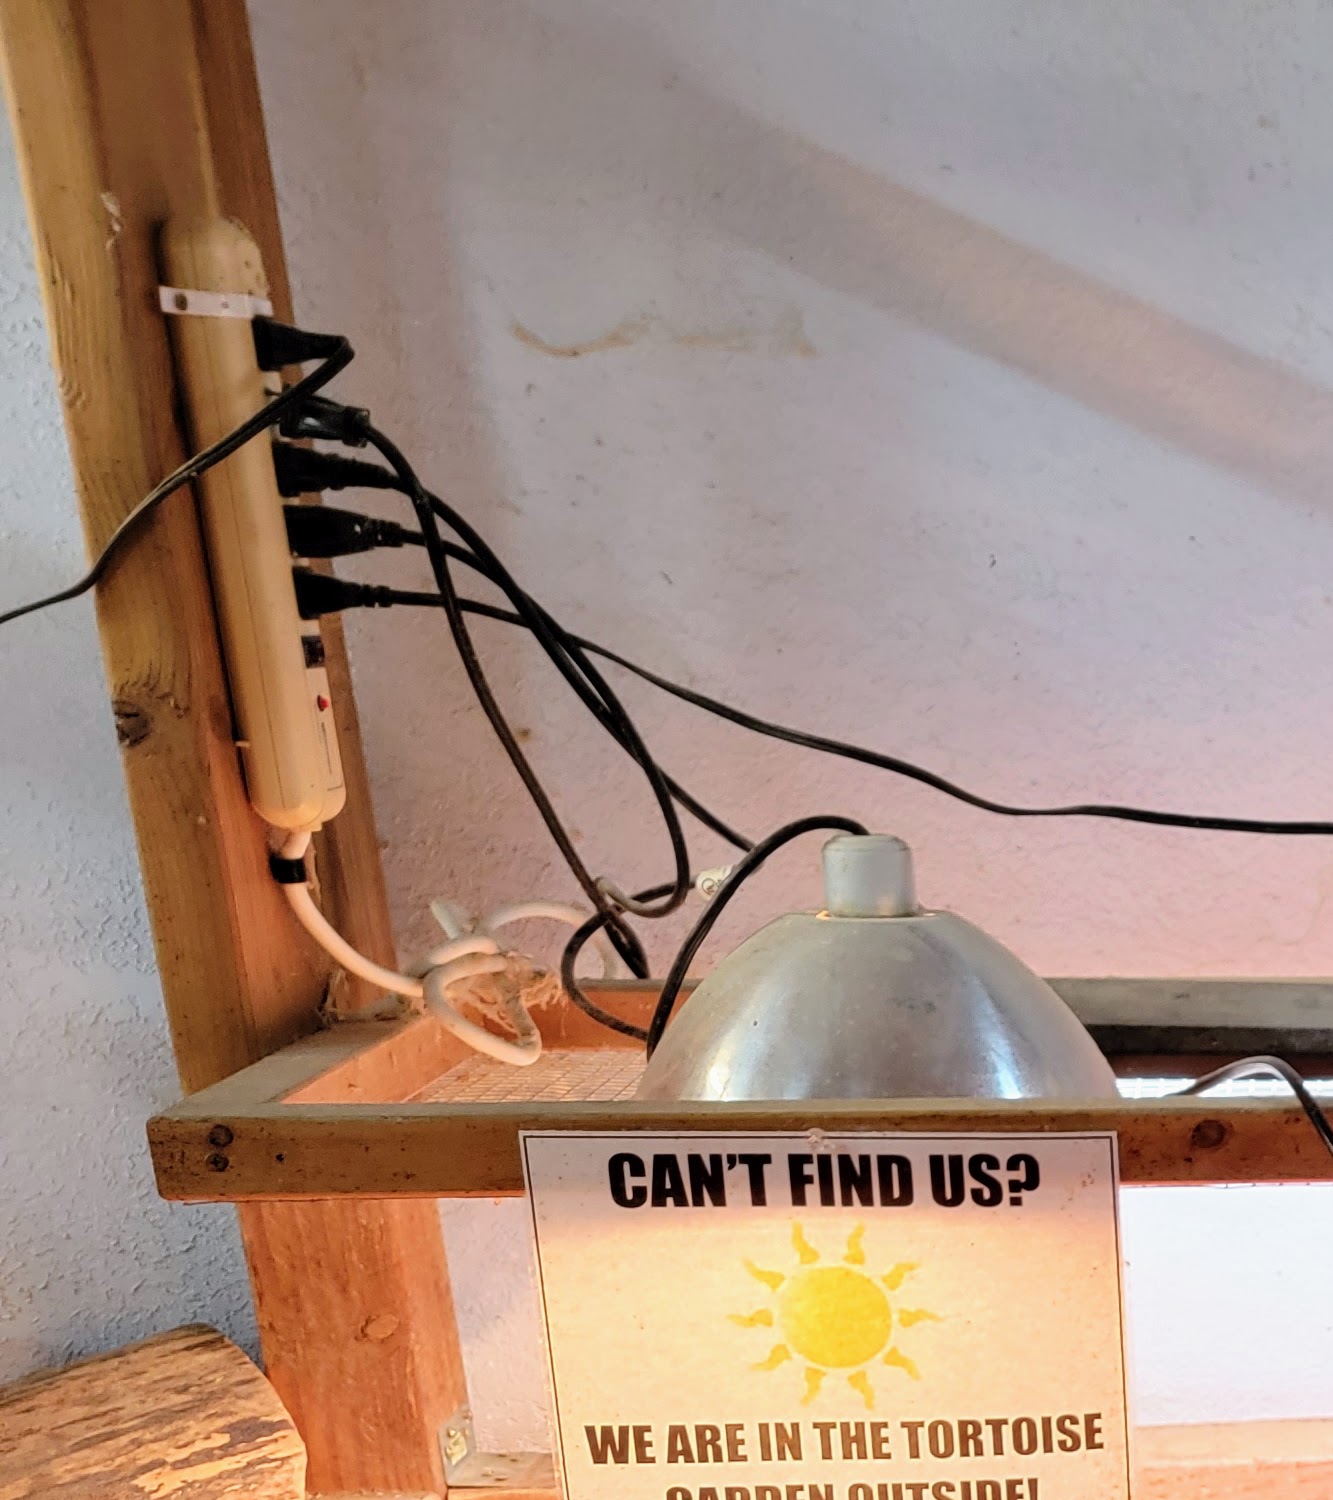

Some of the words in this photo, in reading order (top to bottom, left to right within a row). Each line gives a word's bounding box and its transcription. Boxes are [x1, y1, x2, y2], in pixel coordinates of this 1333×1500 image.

[608, 1152, 772, 1208] CAN'T
[787, 1153, 914, 1208] FIND
[928, 1153, 1041, 1208] US?
[584, 1424, 657, 1465] WE
[666, 1422, 749, 1464] ARE
[758, 1421, 803, 1462] IN
[812, 1421, 892, 1461] THE
[900, 1412, 1105, 1460] TORTOISE
